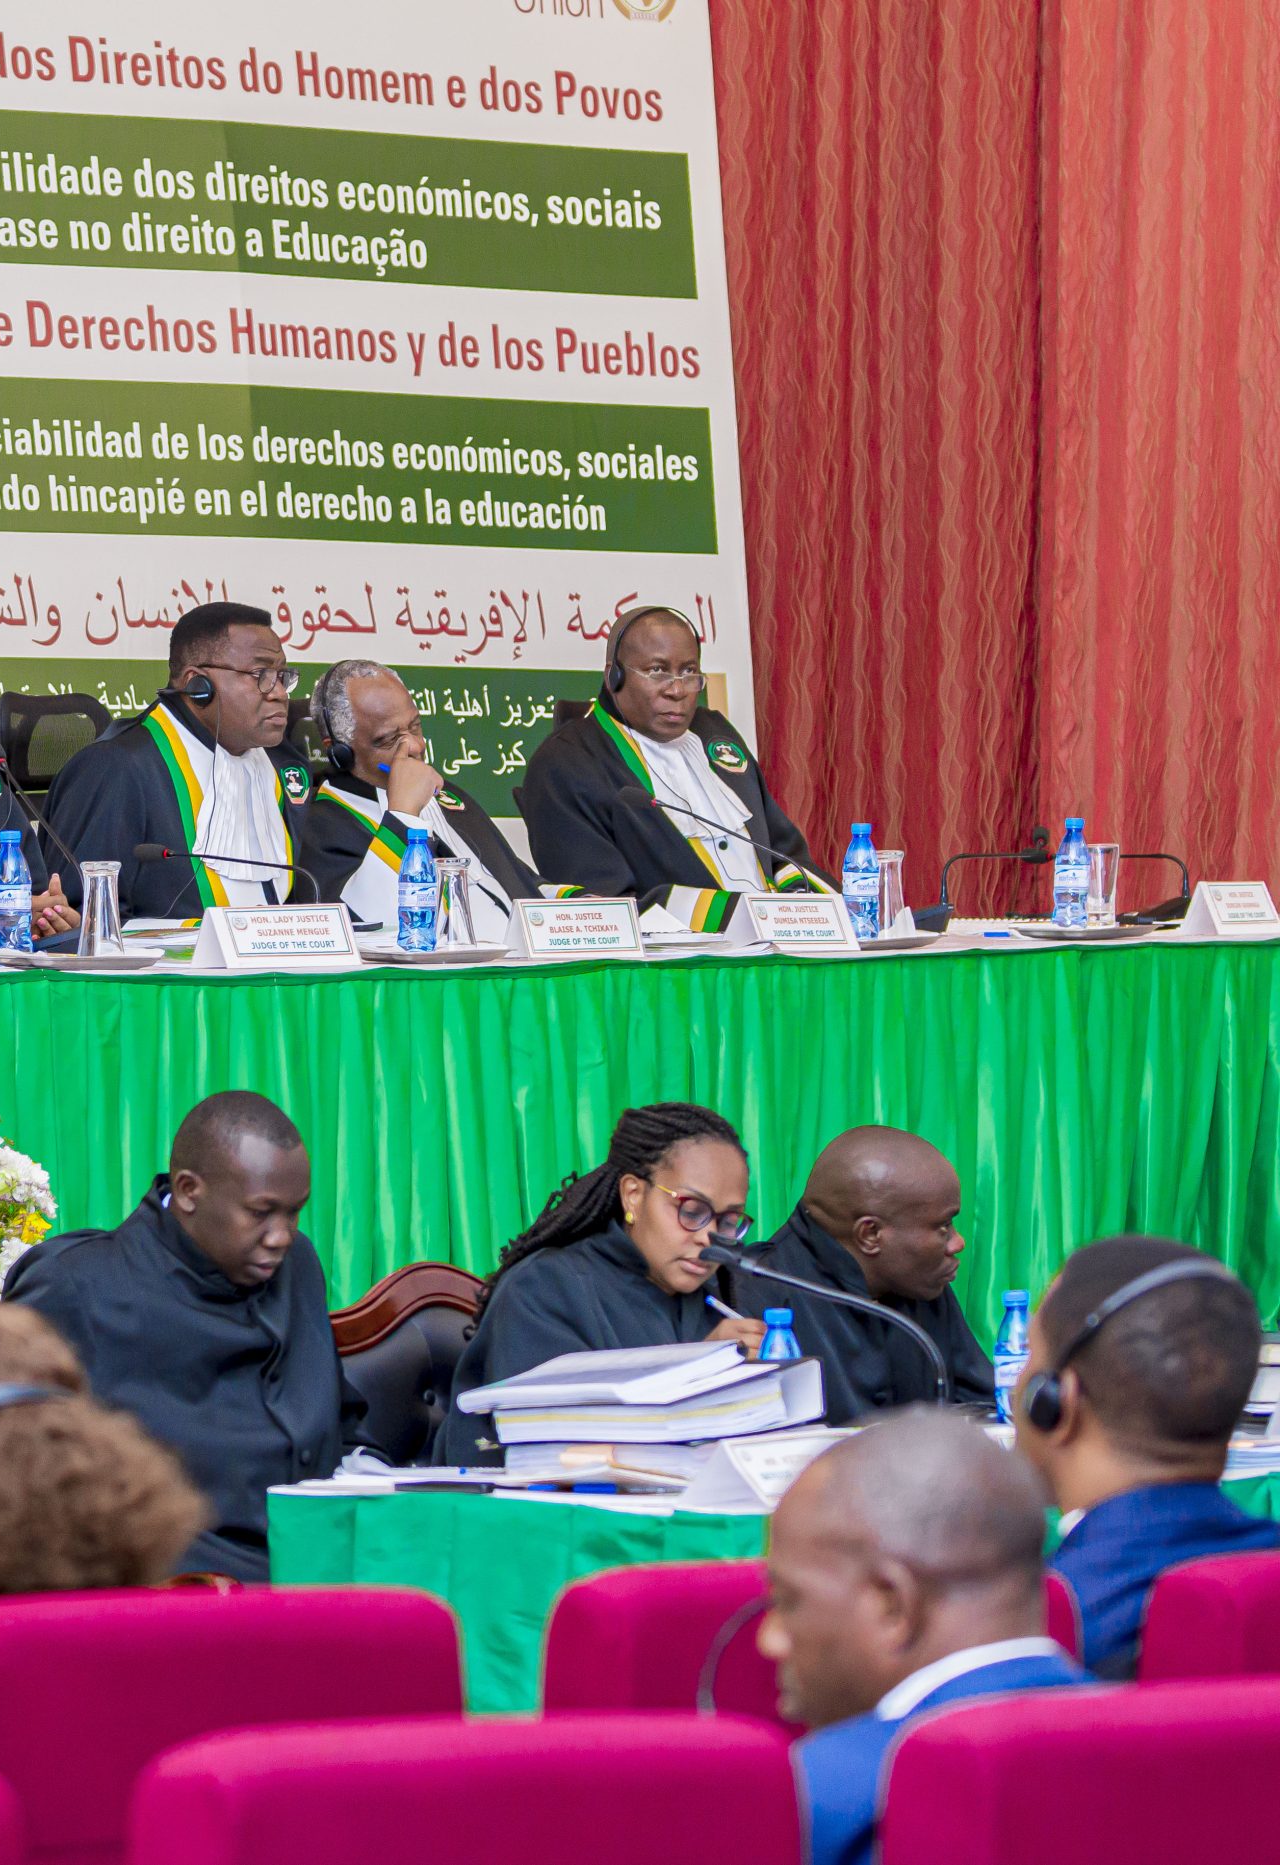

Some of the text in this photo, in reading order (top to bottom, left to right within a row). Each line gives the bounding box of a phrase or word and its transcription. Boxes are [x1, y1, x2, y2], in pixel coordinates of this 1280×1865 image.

[69, 36, 226, 90] Direitos
[240, 48, 283, 95] do
[296, 50, 433, 106] Homem
[447, 76, 465, 109] e
[480, 65, 543, 113] dos
[554, 70, 662, 122] Povos
[134, 158, 195, 199] dos
[206, 161, 328, 208] direitos
[338, 176, 538, 227] económicos,
[547, 188, 661, 229] sociais
[69, 221, 111, 251] no
[123, 212, 235, 255] direito
[246, 229, 263, 257] a
[272, 220, 427, 276] Educação
[26, 300, 216, 352] Derechos
[230, 308, 397, 363] Humanos
[408, 332, 425, 376] y
[439, 321, 479, 368] de
[492, 324, 544, 371] los
[555, 327, 700, 379] Pueblos
[152, 423, 188, 459] de
[198, 424, 244, 461] los
[253, 426, 384, 467] derechos
[393, 437, 570, 480] económicos,
[578, 444, 698, 481] sociales
[49, 475, 185, 523] hincapié
[195, 489, 231, 515] en
[241, 481, 267, 516] el
[277, 482, 392, 522] derecho
[401, 497, 417, 523] a
[425, 488, 451, 524] la
[460, 491, 606, 530] educación
[271, 582, 378, 651] لحقوق
[395, 588, 546, 663] الإفريقية
[567, 592, 717, 645] الكمة
[444, 685, 490, 724] أهلية
[442, 737, 482, 775] على
[250, 914, 330, 924] HON. LADY JUSTICE
[257, 927, 330, 936] SUZANNE MENGUE
[549, 926, 574, 934] BLAISE
[556, 912, 603, 921] HON. JUSTICE
[793, 930, 803, 938] OF
[816, 929, 836, 938] COURT
[251, 940, 336, 949] JUDGE OF THE COURT
[549, 938, 571, 946] JUDGE
[583, 937, 597, 945] THE
[598, 936, 620, 945] COURT
